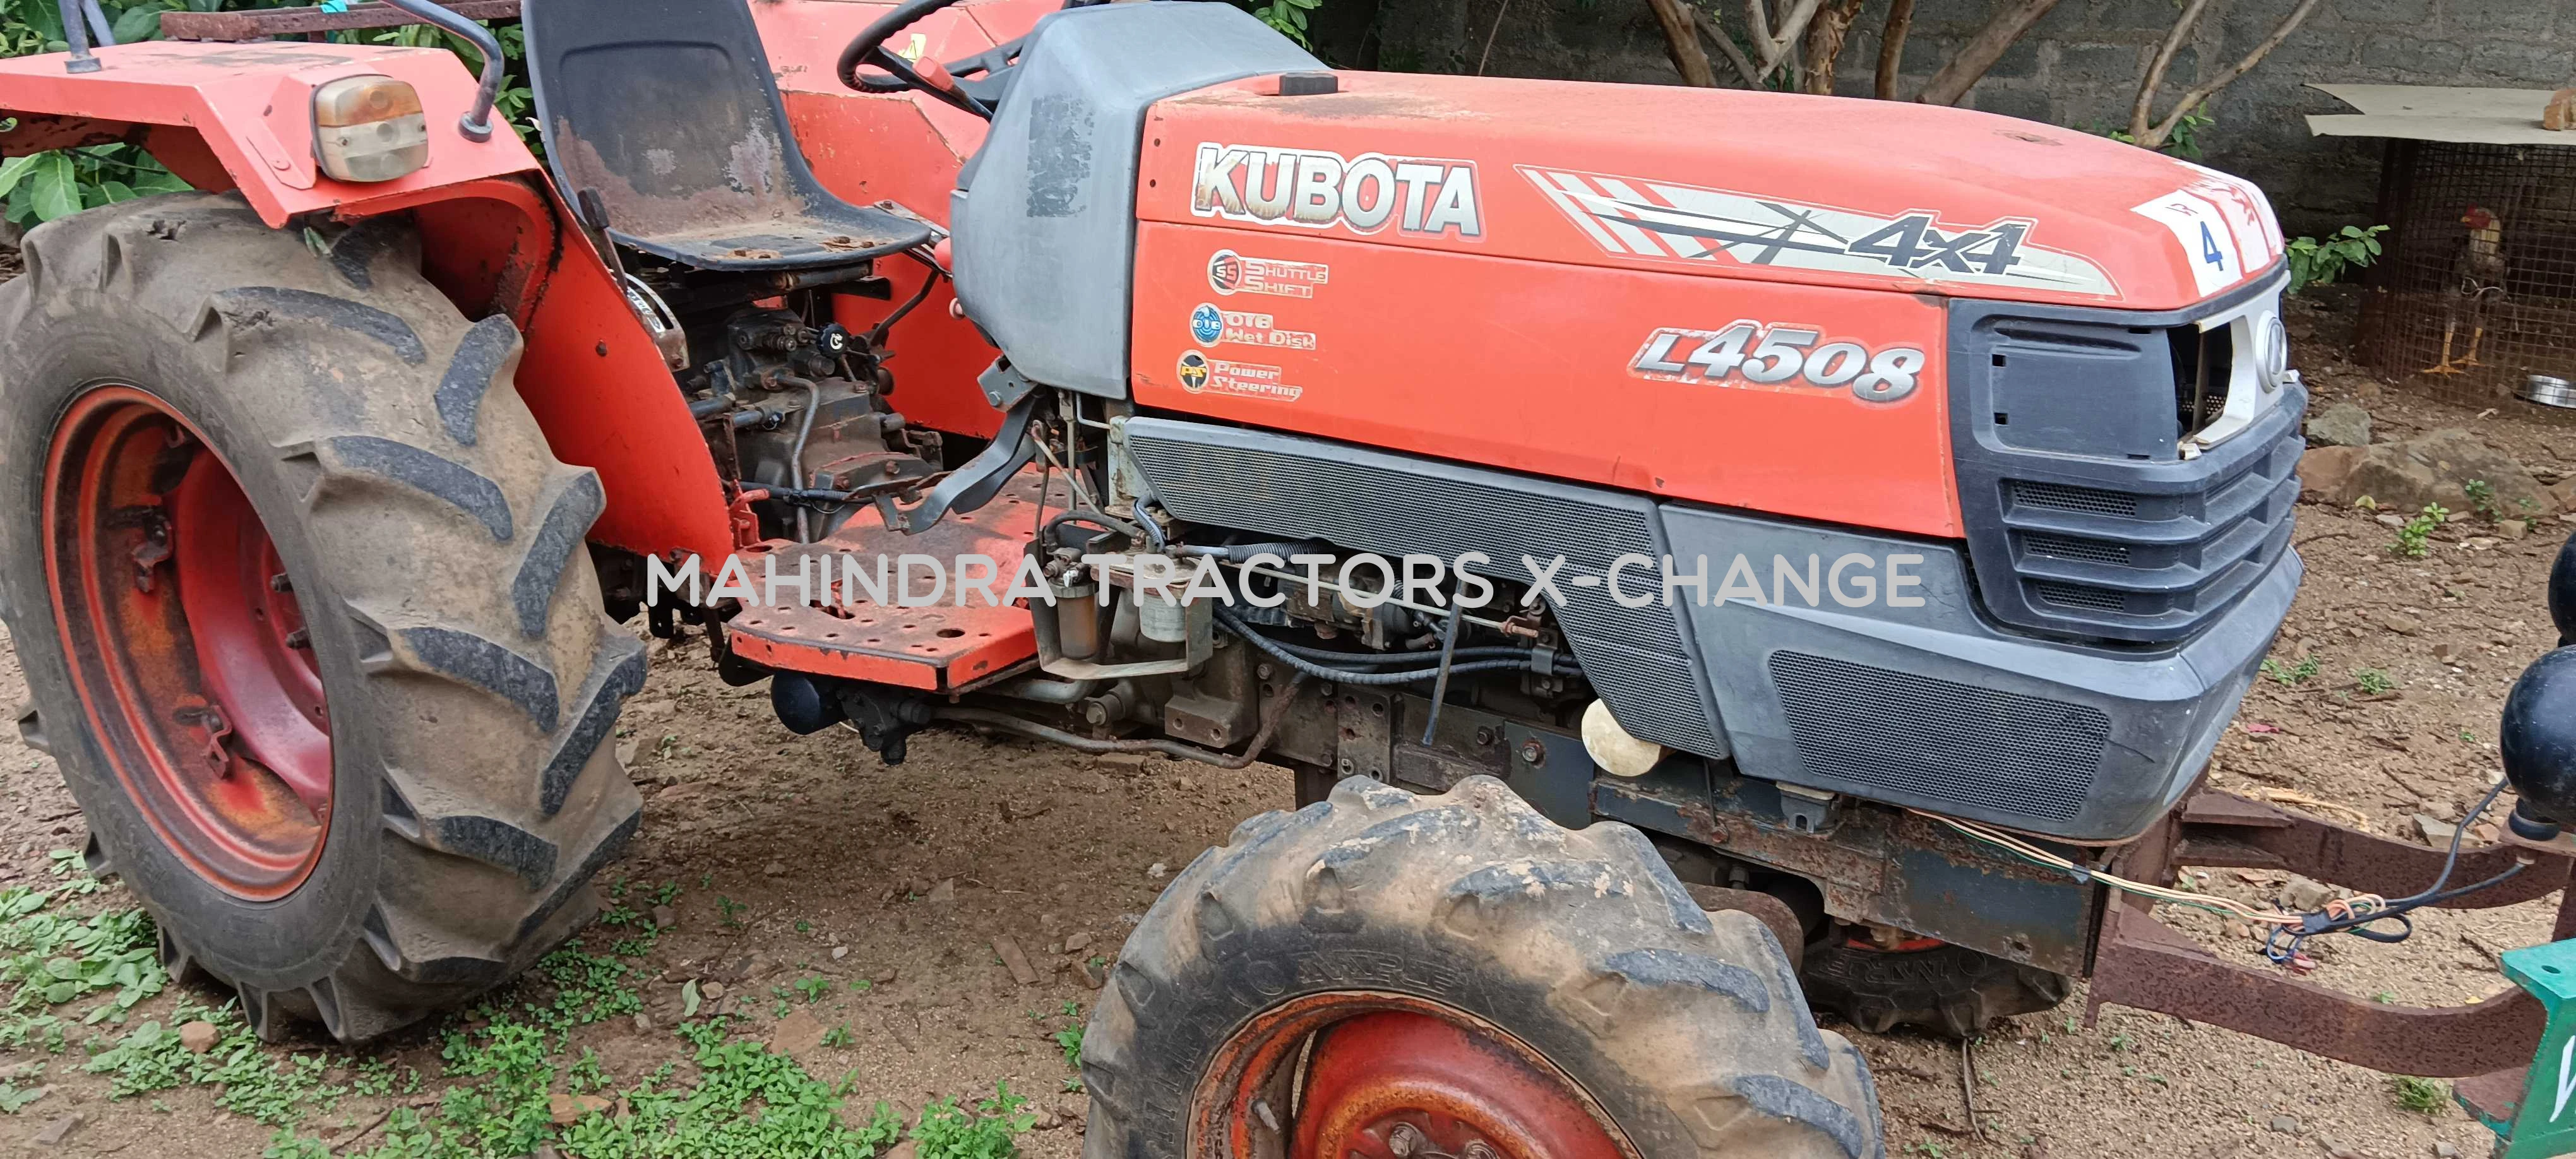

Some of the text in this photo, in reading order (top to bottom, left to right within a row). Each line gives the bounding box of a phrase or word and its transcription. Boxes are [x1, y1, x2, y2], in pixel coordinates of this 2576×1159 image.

[1194, 146, 1481, 236] KUBOTA
[1846, 214, 2029, 276] 4x4
[2200, 220, 2224, 271] 4
[1245, 260, 1327, 282] SHUTTLE
[1244, 275, 1313, 296] SHIFT
[1226, 328, 1314, 347] Wet Disk
[1214, 362, 1280, 379] Power
[1635, 324, 1926, 402] L4508
[1210, 376, 1303, 401] Steering
